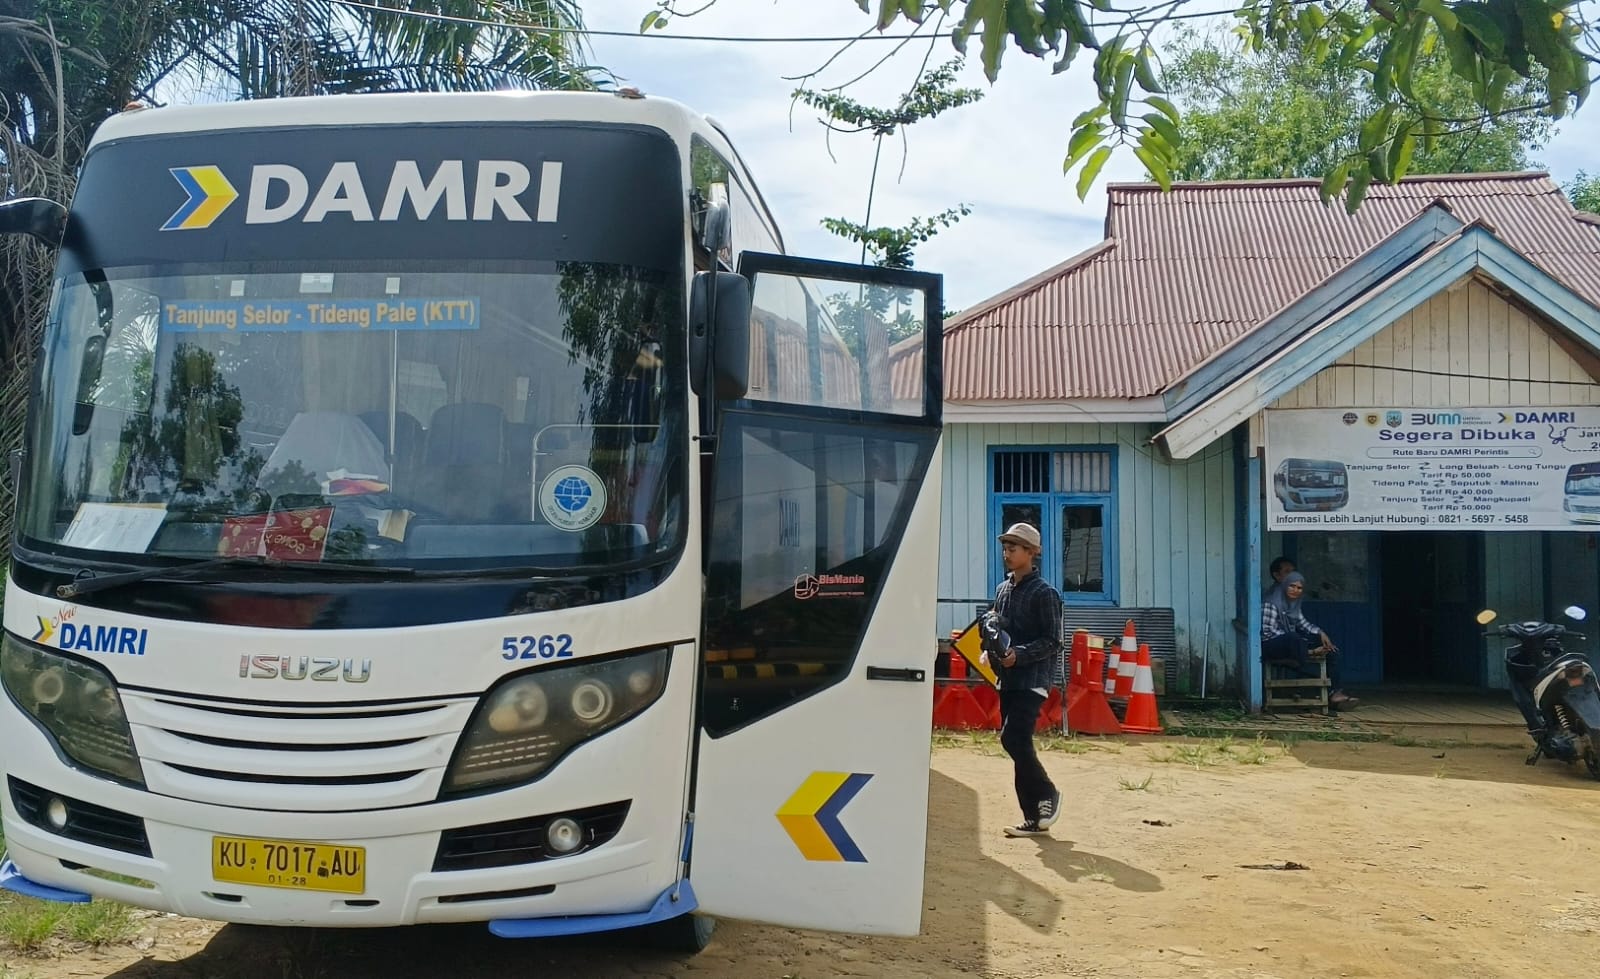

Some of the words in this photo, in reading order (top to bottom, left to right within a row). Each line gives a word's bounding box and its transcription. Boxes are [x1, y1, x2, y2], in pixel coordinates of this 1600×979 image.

[245, 160, 563, 224] DAMRI
[165, 304, 238, 329] Tanjung
[243, 304, 291, 324] Selor
[308, 303, 371, 328] Tideng
[376, 302, 417, 323] Pale
[423, 300, 476, 326] (KTT)
[1515, 411, 1575, 423] DAMRI
[1379, 429, 1453, 443] Segera
[1461, 428, 1536, 441] Dibuka
[1440, 448, 1472, 456] DAMRI
[1276, 514, 1321, 523] Informasi
[1324, 514, 1350, 523] Lebih
[1352, 514, 1384, 525] Lanjut
[1387, 514, 1430, 525] Hubungi
[1438, 514, 1461, 523] 0821
[1471, 514, 1495, 523] 5697
[1504, 514, 1529, 523] 5458
[819, 574, 864, 584] BisMania
[51, 604, 78, 629] New
[60, 623, 148, 655] DAMRI
[501, 634, 574, 660] 5262
[239, 654, 372, 683] ISUZU
[220, 841, 246, 867] KU
[263, 844, 316, 873] 7017
[331, 849, 357, 876] AU
